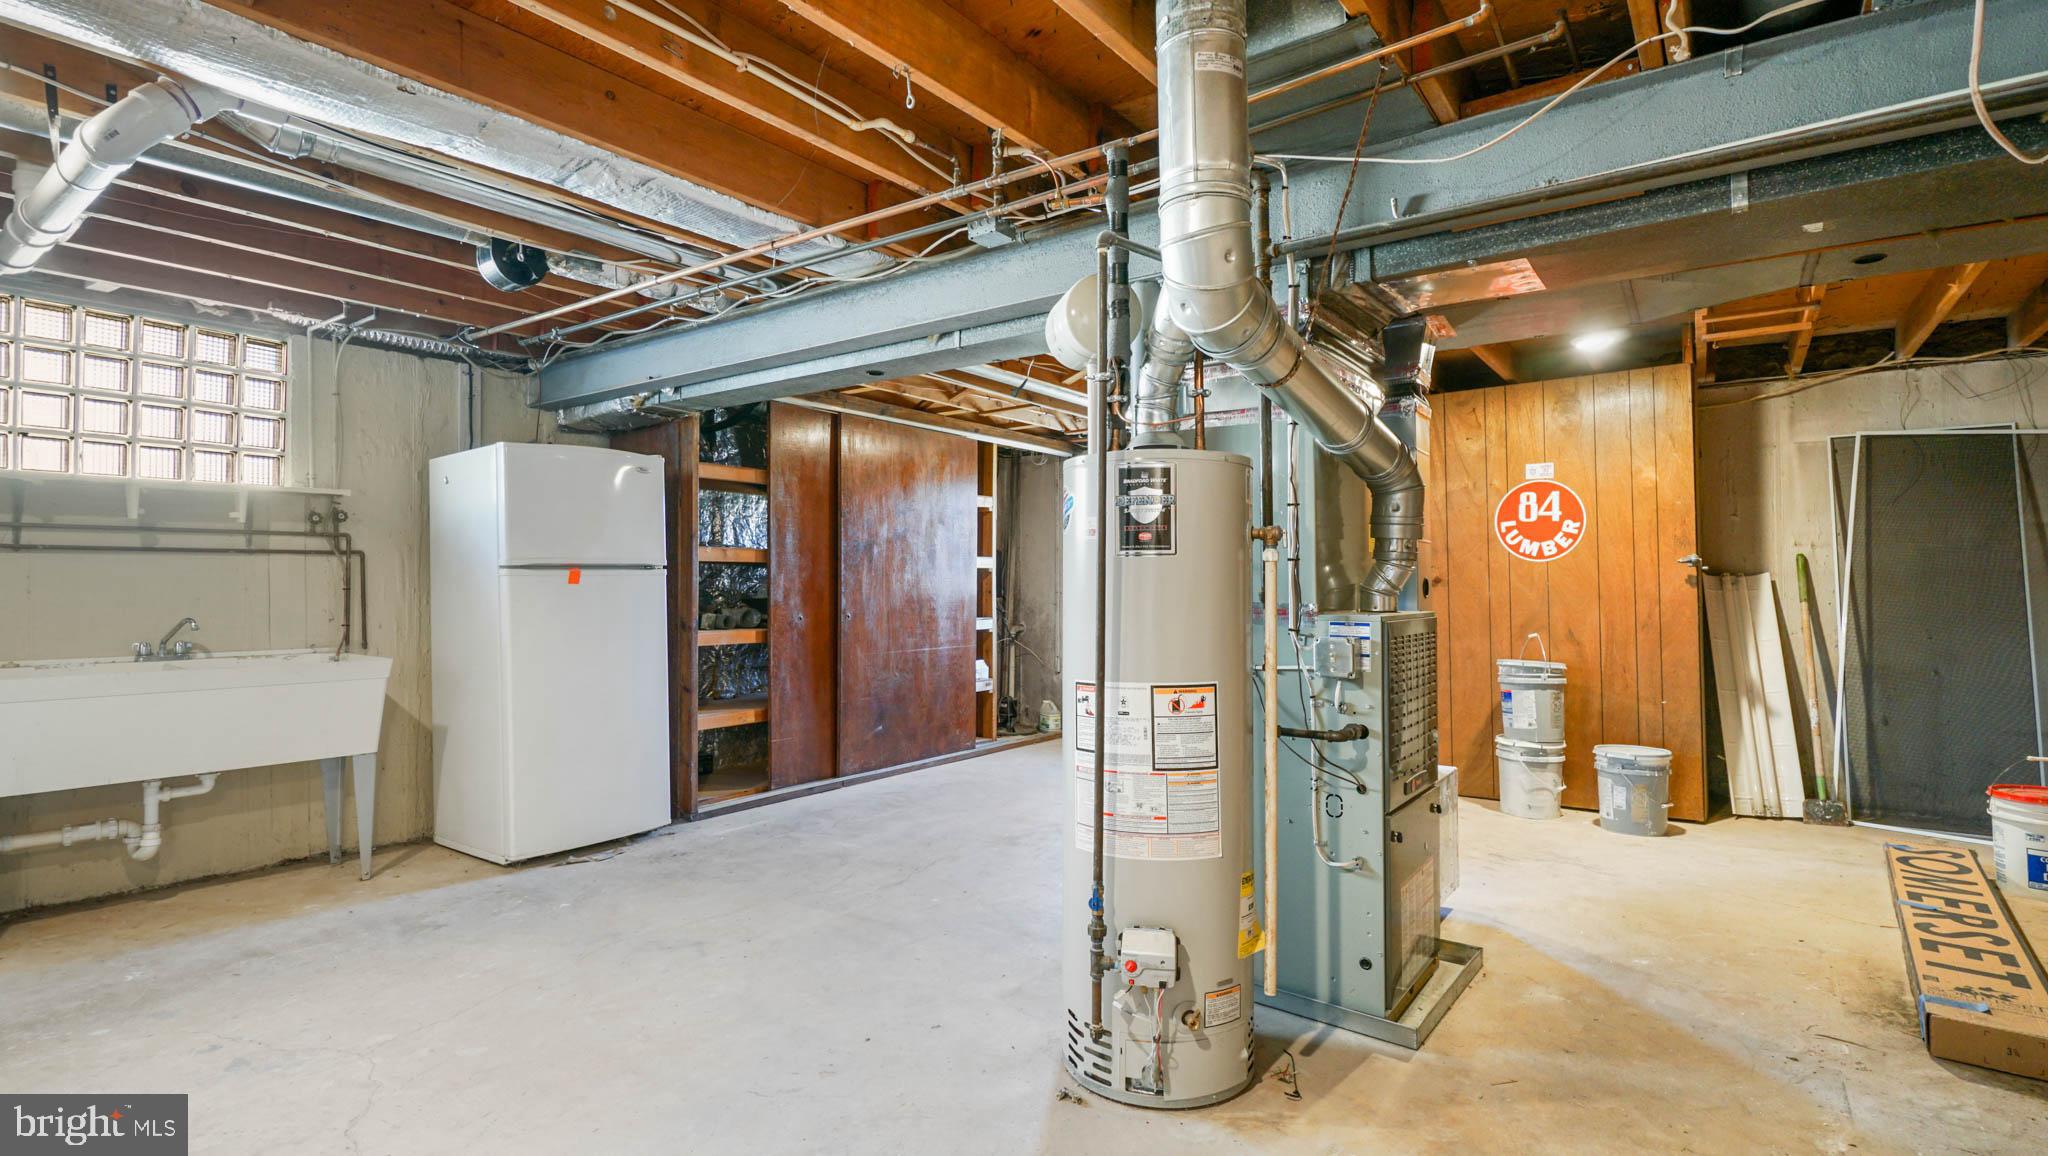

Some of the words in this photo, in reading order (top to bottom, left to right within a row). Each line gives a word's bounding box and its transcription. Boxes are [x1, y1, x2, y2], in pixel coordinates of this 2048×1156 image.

[1116, 495, 1175, 506] DEFENDER
[1518, 490, 1562, 522] 84
[1500, 519, 1581, 556] LUMBER
